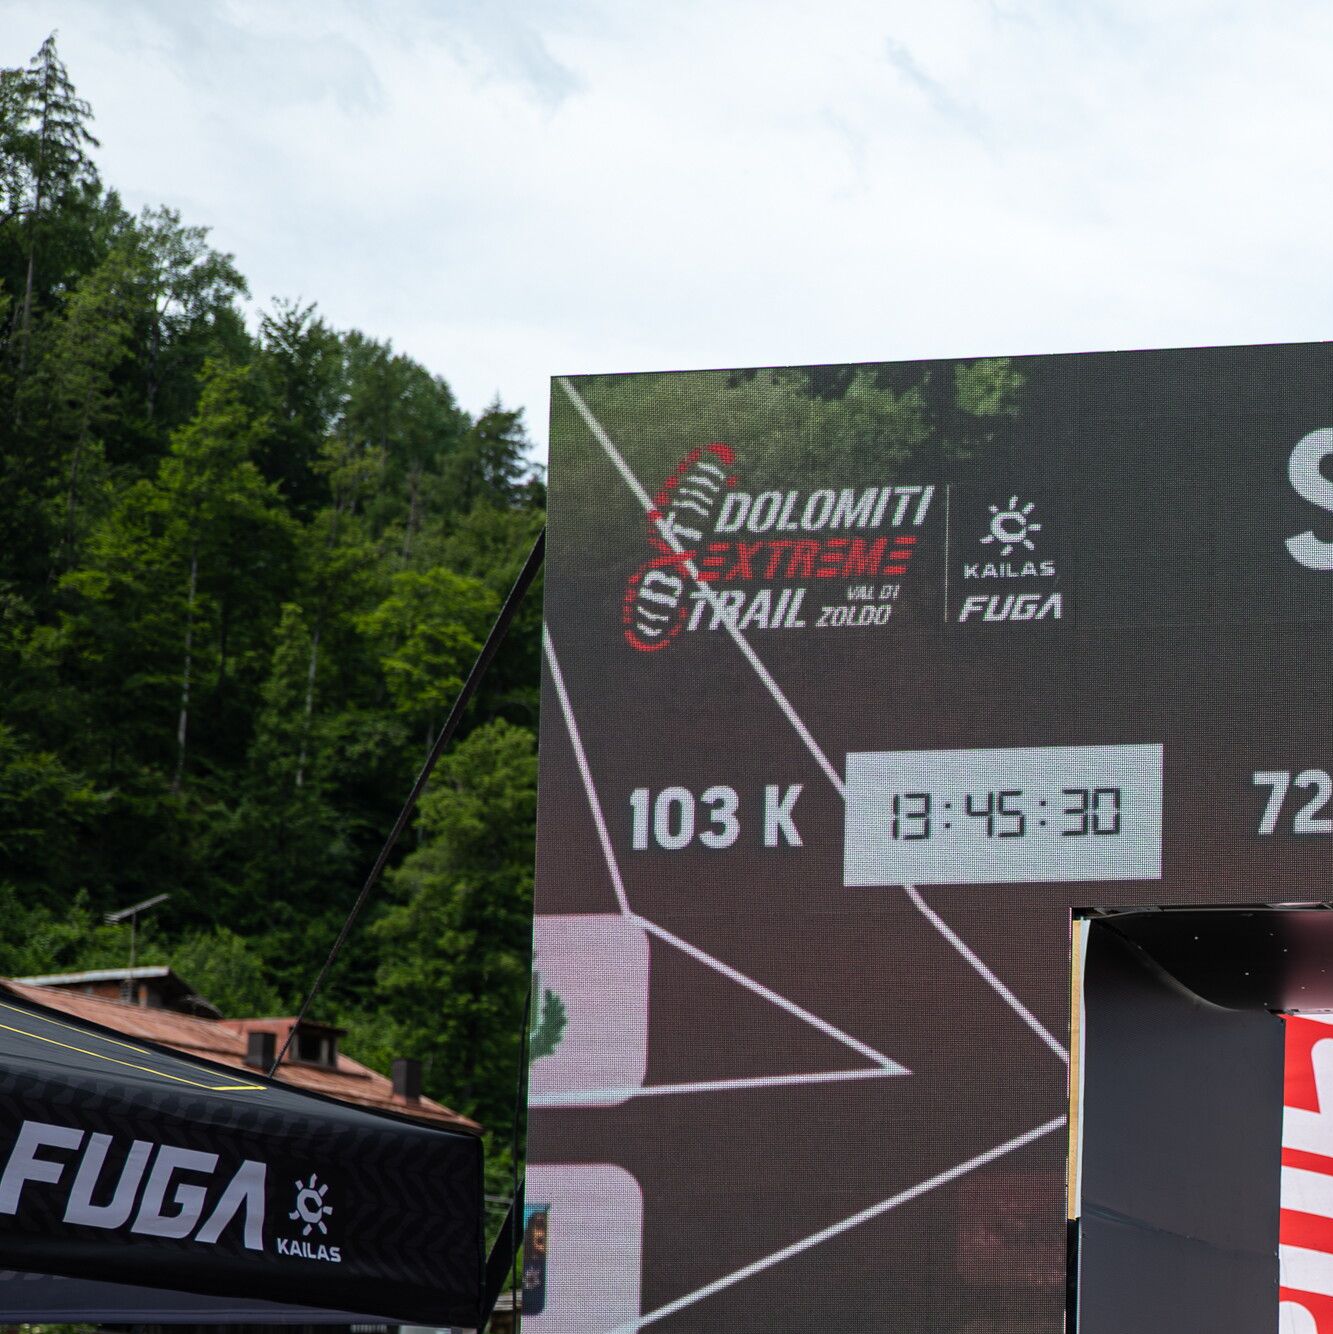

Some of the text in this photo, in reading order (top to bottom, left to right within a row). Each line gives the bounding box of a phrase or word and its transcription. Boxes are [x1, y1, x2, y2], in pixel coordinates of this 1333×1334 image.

[714, 485, 935, 533] DOLOMITI
[697, 535, 918, 582] EXTREME
[964, 561, 1056, 578] KAILAS
[687, 588, 807, 631] TRAIL
[816, 604, 892, 627] ZOLDO
[959, 593, 1063, 621] FUGA
[630, 783, 804, 850] 103 K
[893, 787, 1121, 840] 13:45:30
[1253, 768, 1333, 835] 72
[0, 1120, 267, 1251] FUGA
[276, 1237, 342, 1263] KAILAS
